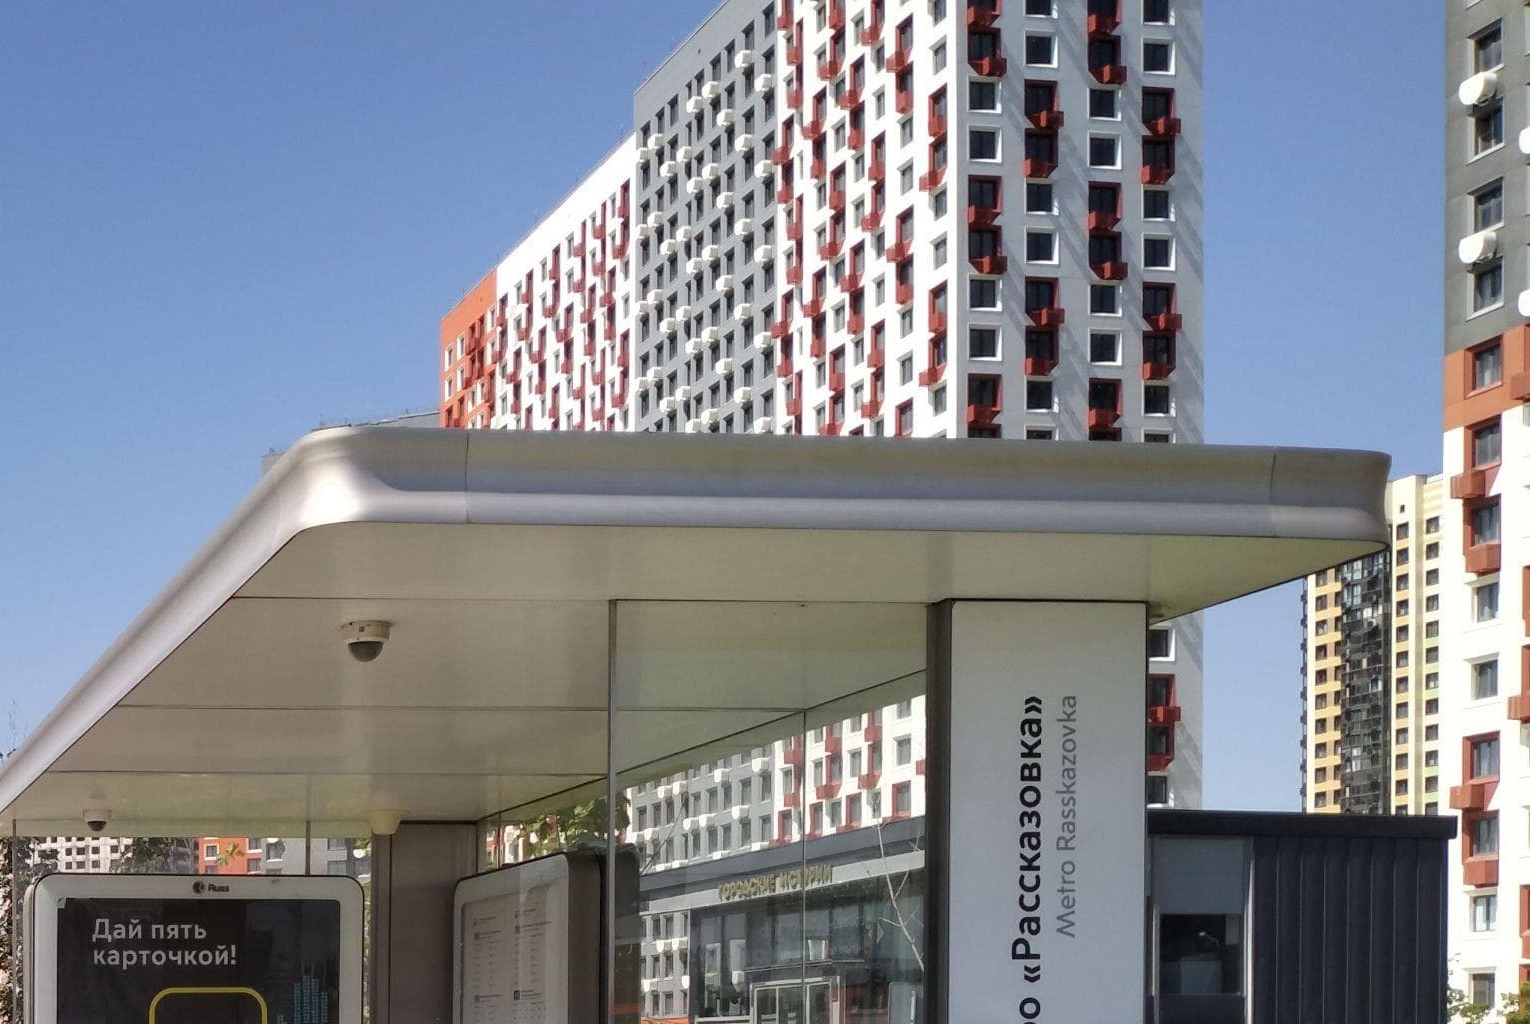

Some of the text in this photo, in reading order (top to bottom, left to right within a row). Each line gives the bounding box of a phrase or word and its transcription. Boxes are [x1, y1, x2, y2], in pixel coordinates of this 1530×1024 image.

[1055, 694, 1078, 939] Metro Rasskazovka
[1011, 695, 1044, 984] «Рассказовка»
[208, 883, 230, 892] Russ
[92, 918, 208, 942] Дай пять
[93, 944, 238, 970] карточкой!
